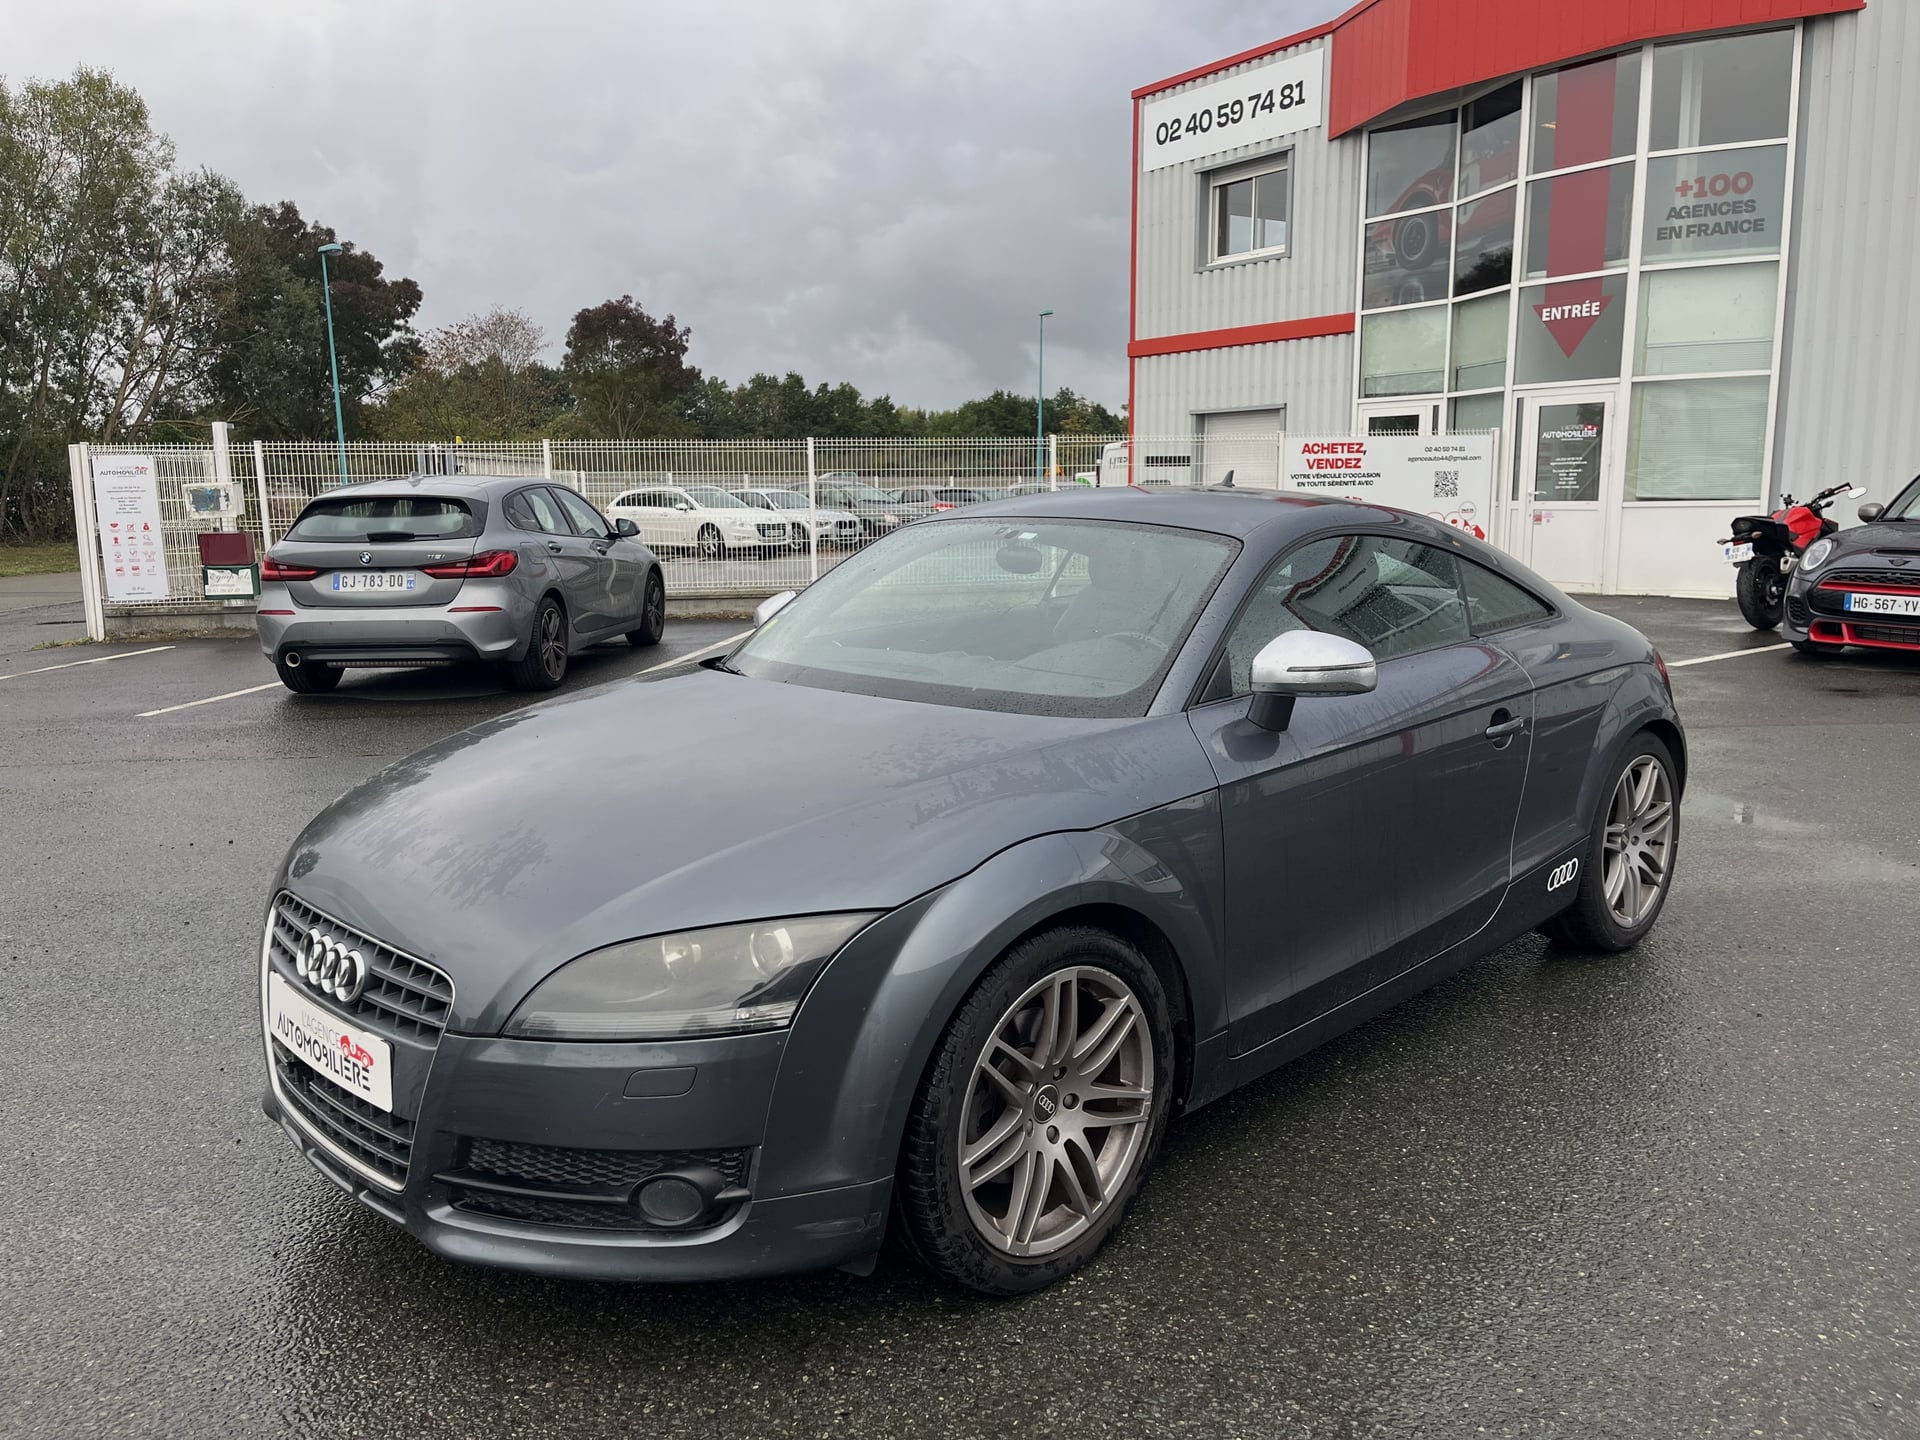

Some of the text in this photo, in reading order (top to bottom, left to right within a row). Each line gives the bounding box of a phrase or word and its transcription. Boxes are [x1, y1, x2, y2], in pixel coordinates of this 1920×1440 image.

[1156, 80, 1306, 146] 02 40 59 74 81
[1675, 171, 1754, 199] +100
[1665, 199, 1757, 221] AGENCES
[1656, 218, 1766, 241] EN FRANCE
[1541, 300, 1601, 322] ENTRÉE
[1301, 442, 1367, 456] ACHETEZ,
[1306, 457, 1362, 470] VENDEZ
[342, 574, 404, 589] GJ-783-DQ
[1853, 596, 1919, 612] HG-567-YV
